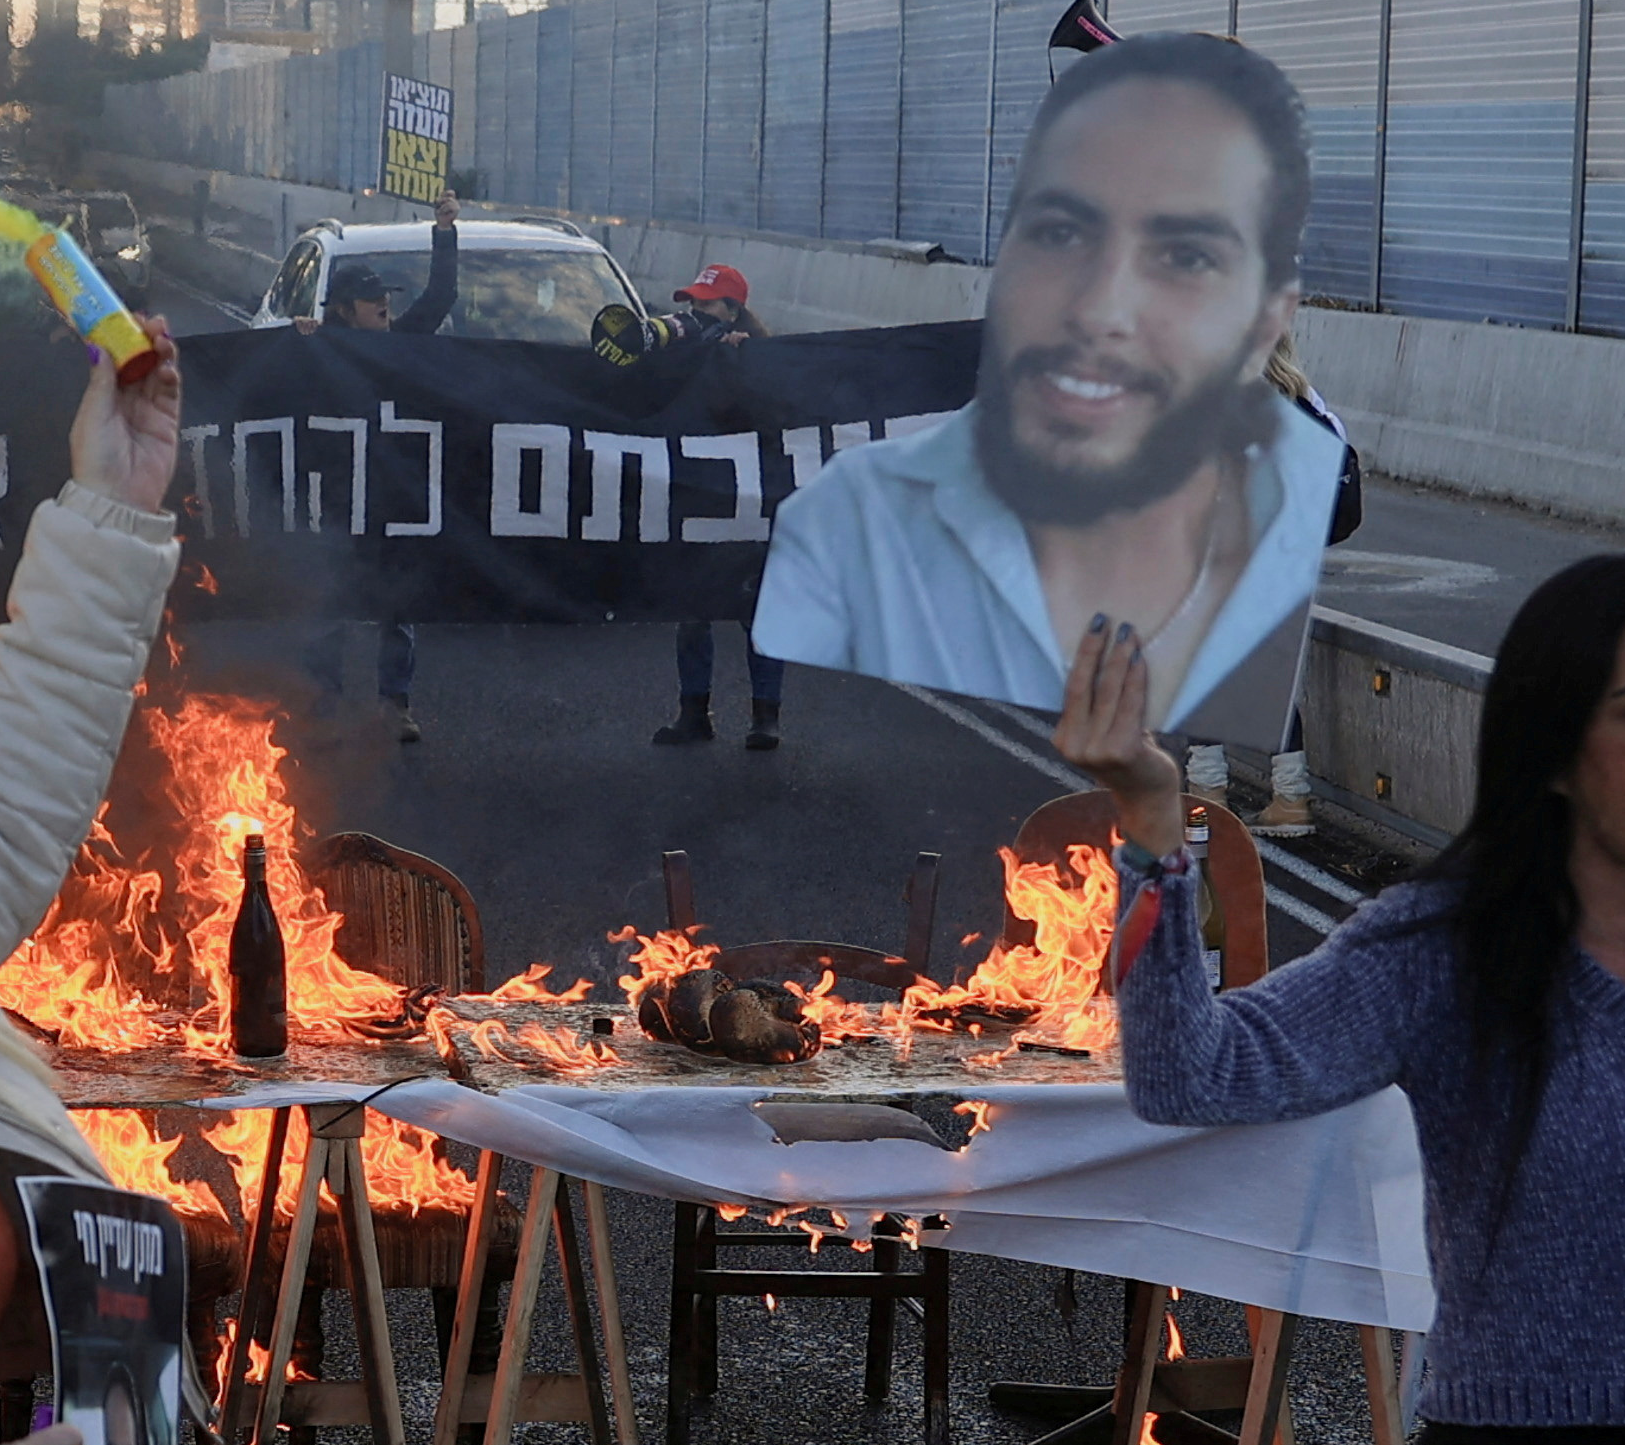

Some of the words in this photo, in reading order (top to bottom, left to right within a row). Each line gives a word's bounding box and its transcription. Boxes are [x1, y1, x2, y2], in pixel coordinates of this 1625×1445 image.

[390, 75, 450, 113] תוציאו
[388, 99, 449, 143] מעזה
[387, 128, 448, 177] וצאו
[385, 163, 445, 203] מעזה
